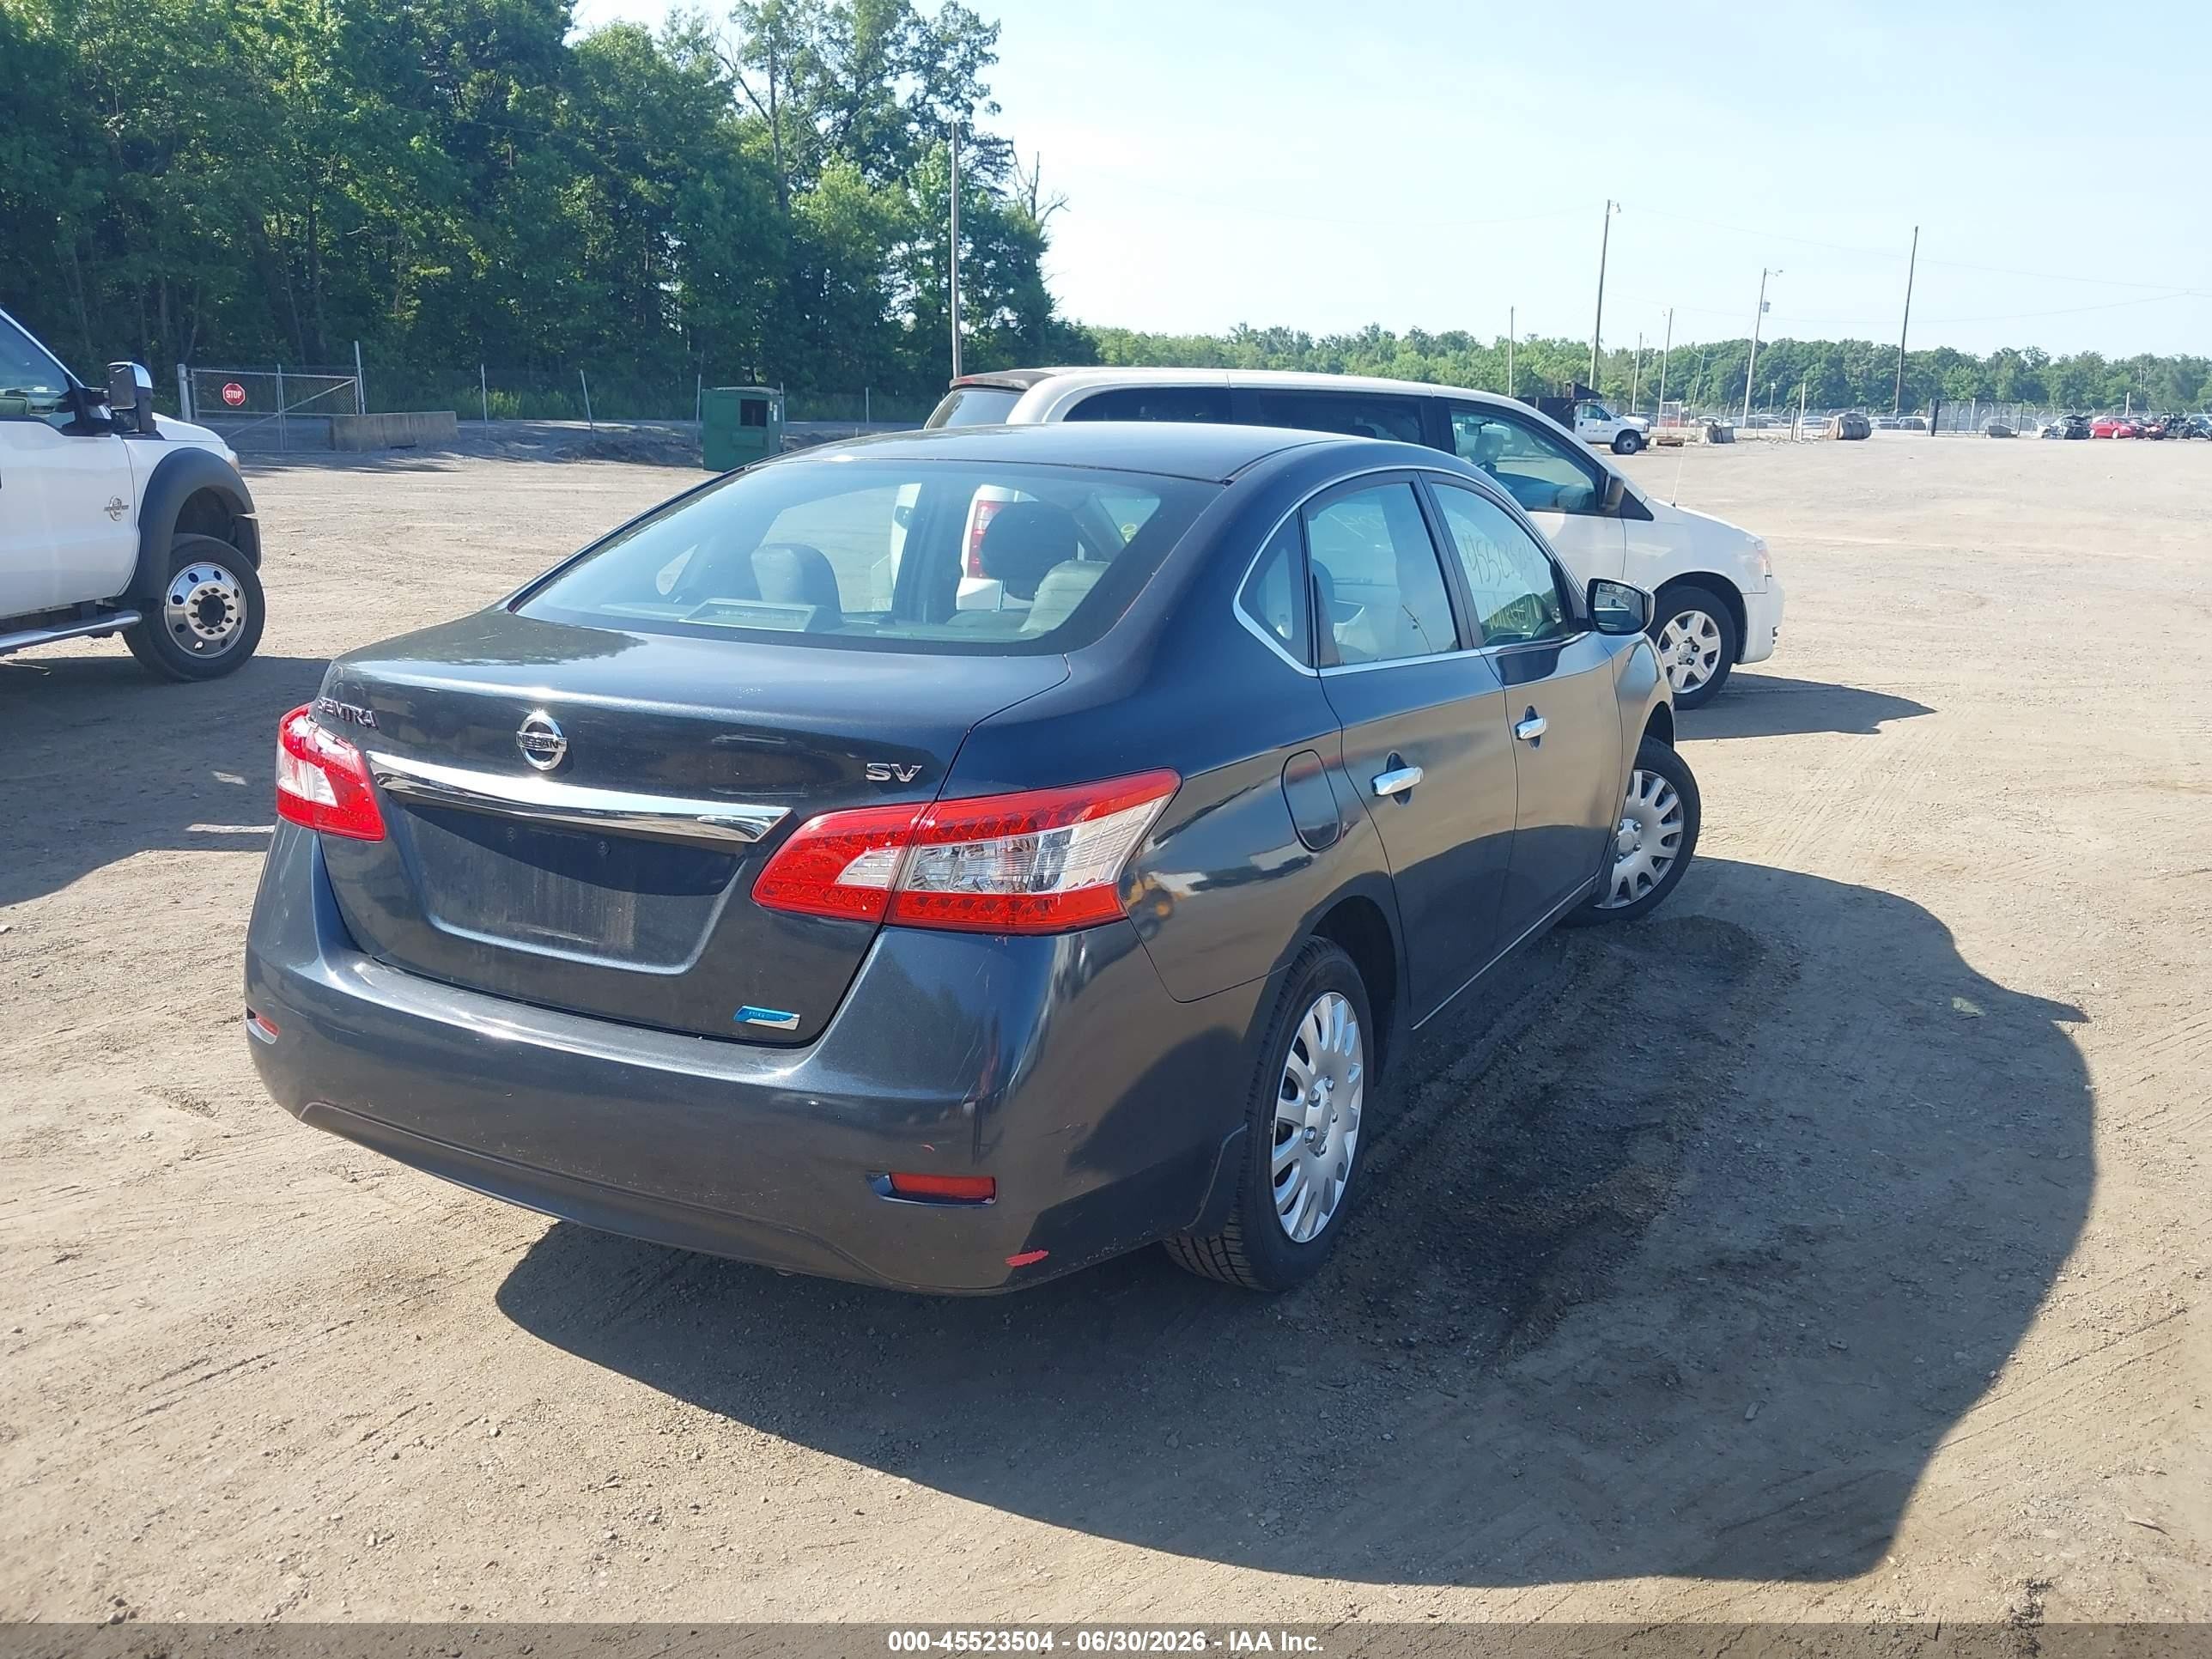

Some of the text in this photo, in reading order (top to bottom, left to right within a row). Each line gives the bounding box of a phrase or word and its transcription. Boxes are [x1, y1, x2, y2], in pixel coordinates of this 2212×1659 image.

[226, 390, 242, 399] STOP
[318, 696, 378, 730] SENTRA
[518, 734, 560, 750] NISSAN
[866, 763, 922, 782] SV
